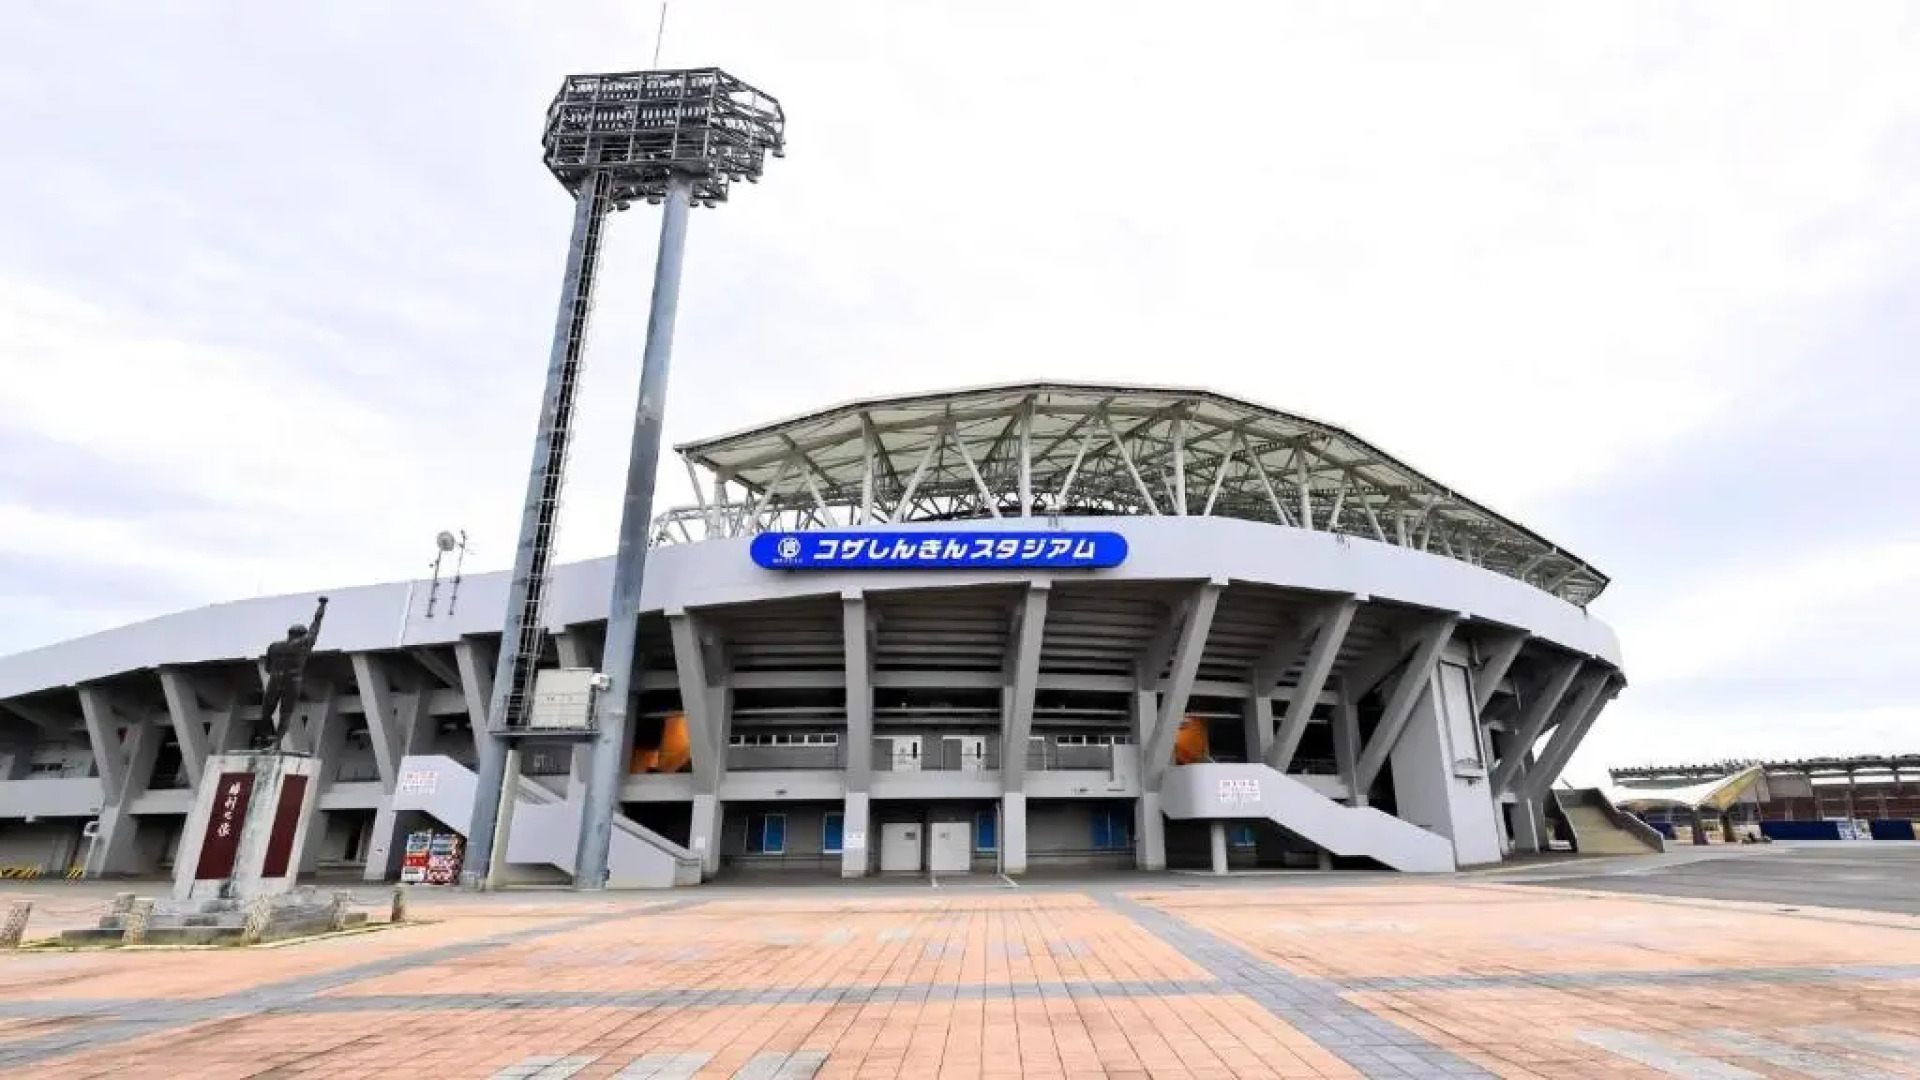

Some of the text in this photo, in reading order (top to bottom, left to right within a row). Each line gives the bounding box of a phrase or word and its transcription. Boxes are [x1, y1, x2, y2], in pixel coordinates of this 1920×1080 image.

[813, 538, 1096, 560] コザしんきんスタジアム
